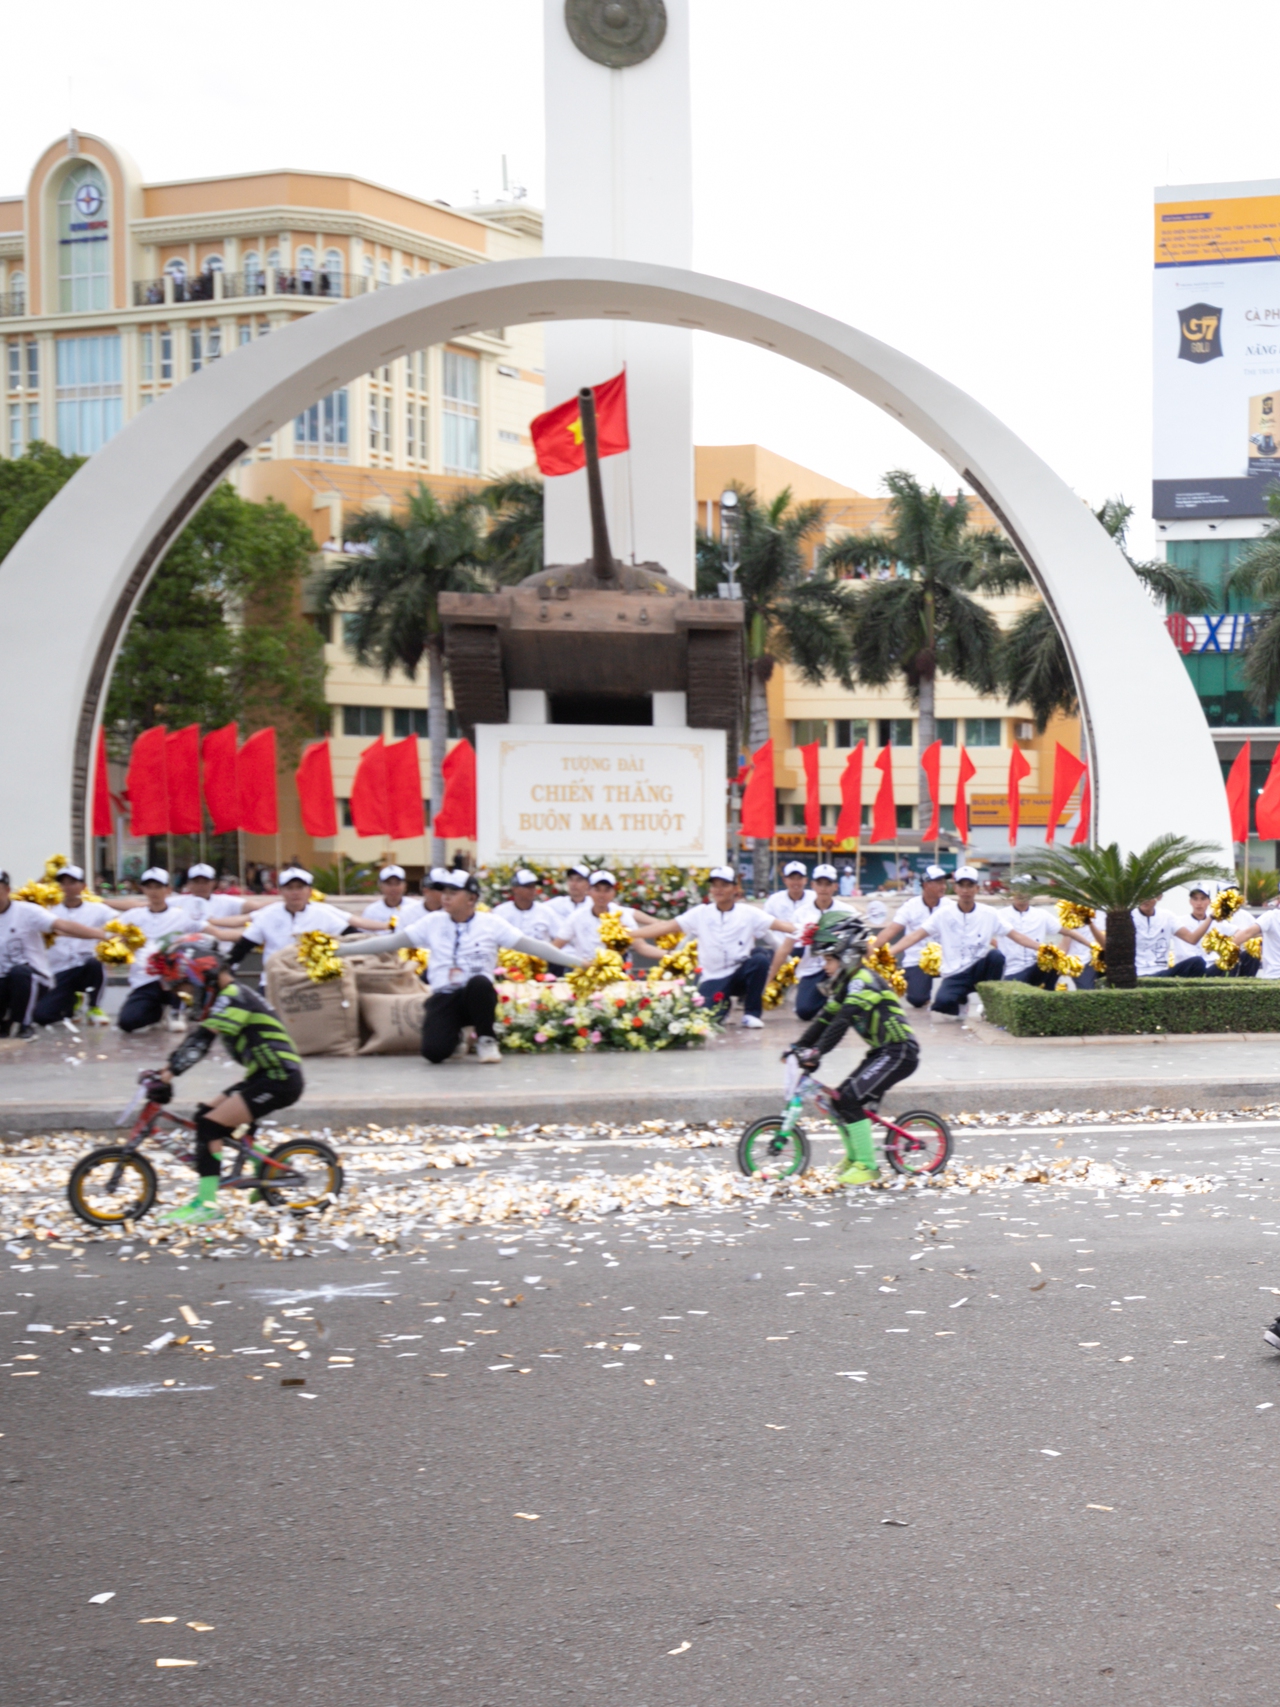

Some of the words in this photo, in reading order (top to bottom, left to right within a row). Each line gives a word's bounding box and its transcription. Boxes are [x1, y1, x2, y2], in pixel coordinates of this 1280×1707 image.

[1245, 307, 1261, 321] CÀ
[1245, 343, 1278, 356] NĂNG
[561, 756, 611, 772] TƯỢNG
[617, 754, 645, 772] ĐÀI
[530, 779, 595, 803] CHIẾN
[602, 779, 673, 803] THẮNG
[519, 808, 571, 831] BUÔN
[581, 813, 613, 831] MA
[618, 808, 685, 835] THUỘT
